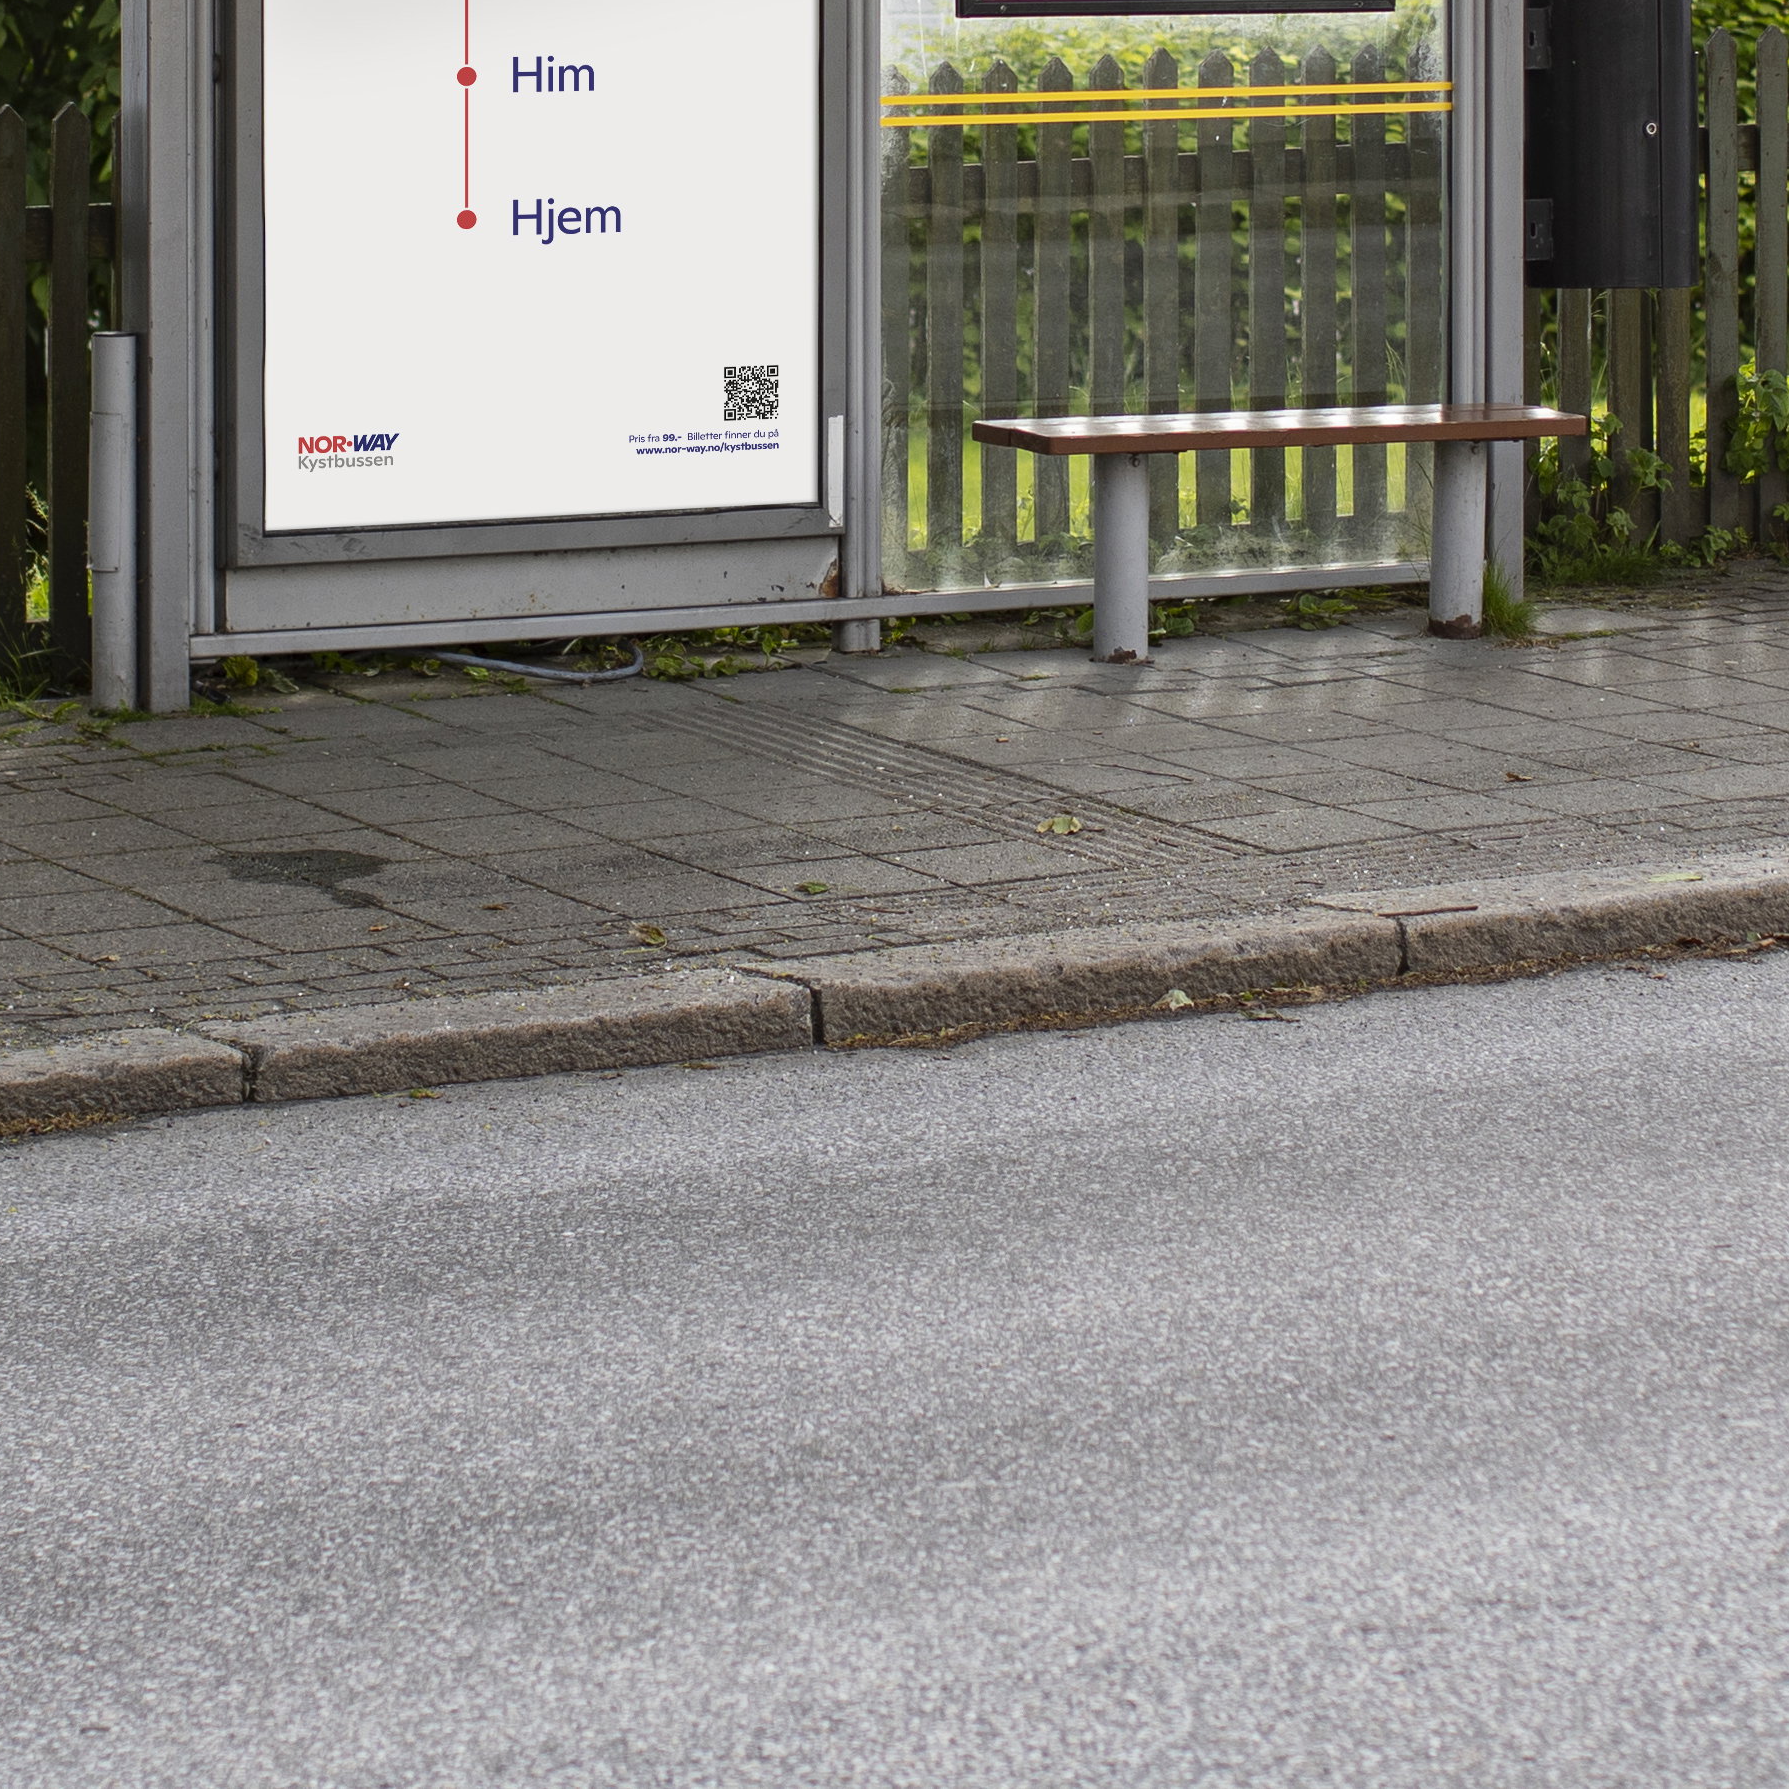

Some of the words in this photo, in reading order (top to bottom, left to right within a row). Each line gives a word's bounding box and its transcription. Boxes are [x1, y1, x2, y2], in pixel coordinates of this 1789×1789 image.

[512, 55, 595, 94] Him
[512, 197, 622, 246] Hjem
[628, 434, 646, 443] Pris
[647, 433, 660, 442] fra
[662, 433, 682, 442] 99.-
[687, 431, 722, 441] Billetter
[724, 430, 751, 439] finner
[753, 429, 766, 438] du
[768, 428, 779, 440] på
[635, 441, 780, 455] www.nor-way.no/kystbussen
[298, 454, 394, 473] Kystbussen
